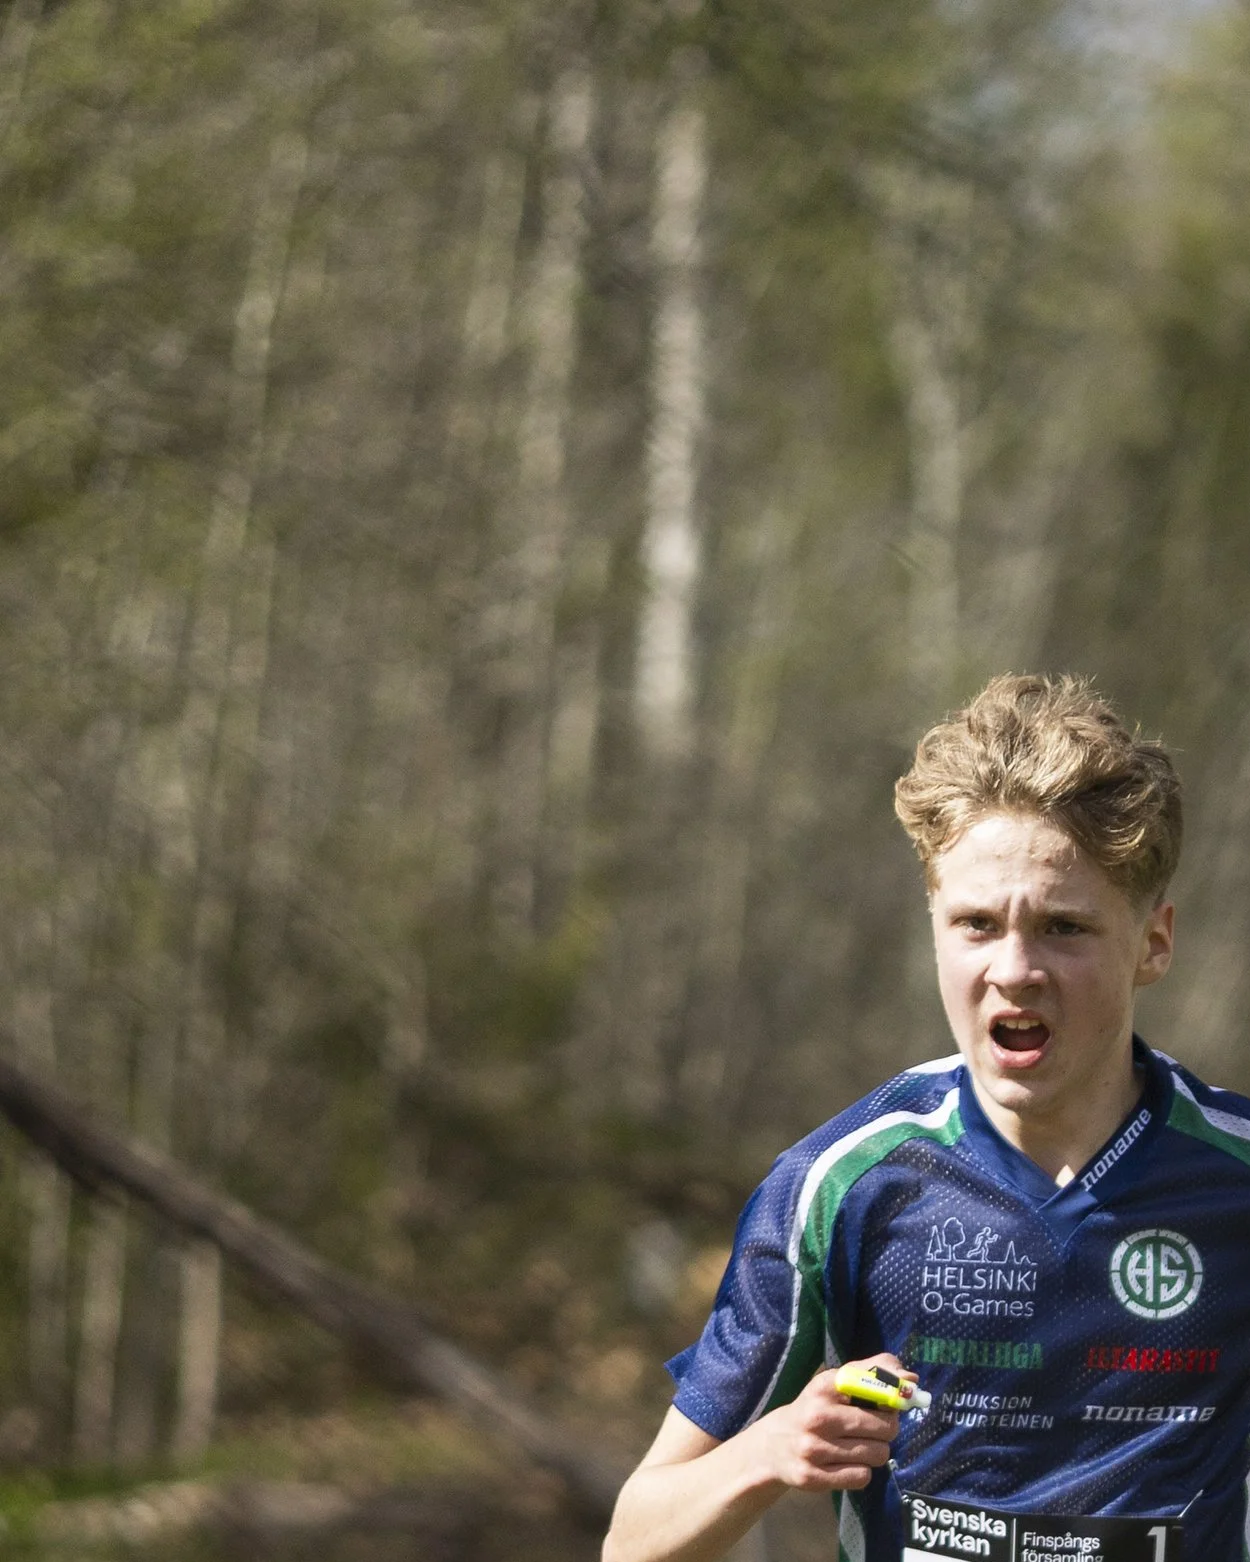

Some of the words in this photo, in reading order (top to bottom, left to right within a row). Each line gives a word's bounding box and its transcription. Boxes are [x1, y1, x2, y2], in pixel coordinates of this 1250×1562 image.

[1080, 1107, 1152, 1192] noname
[922, 1266, 1037, 1292] HELSINKI
[922, 1290, 1035, 1318] O-Games
[941, 1392, 1033, 1410] NUUKSION
[1081, 1405, 1217, 1423] noname
[940, 1410, 1055, 1430] HUURTEINEN
[911, 1498, 1008, 1538] Svenska
[913, 1519, 991, 1557] kyrkan
[1022, 1532, 1101, 1552] Finspångs
